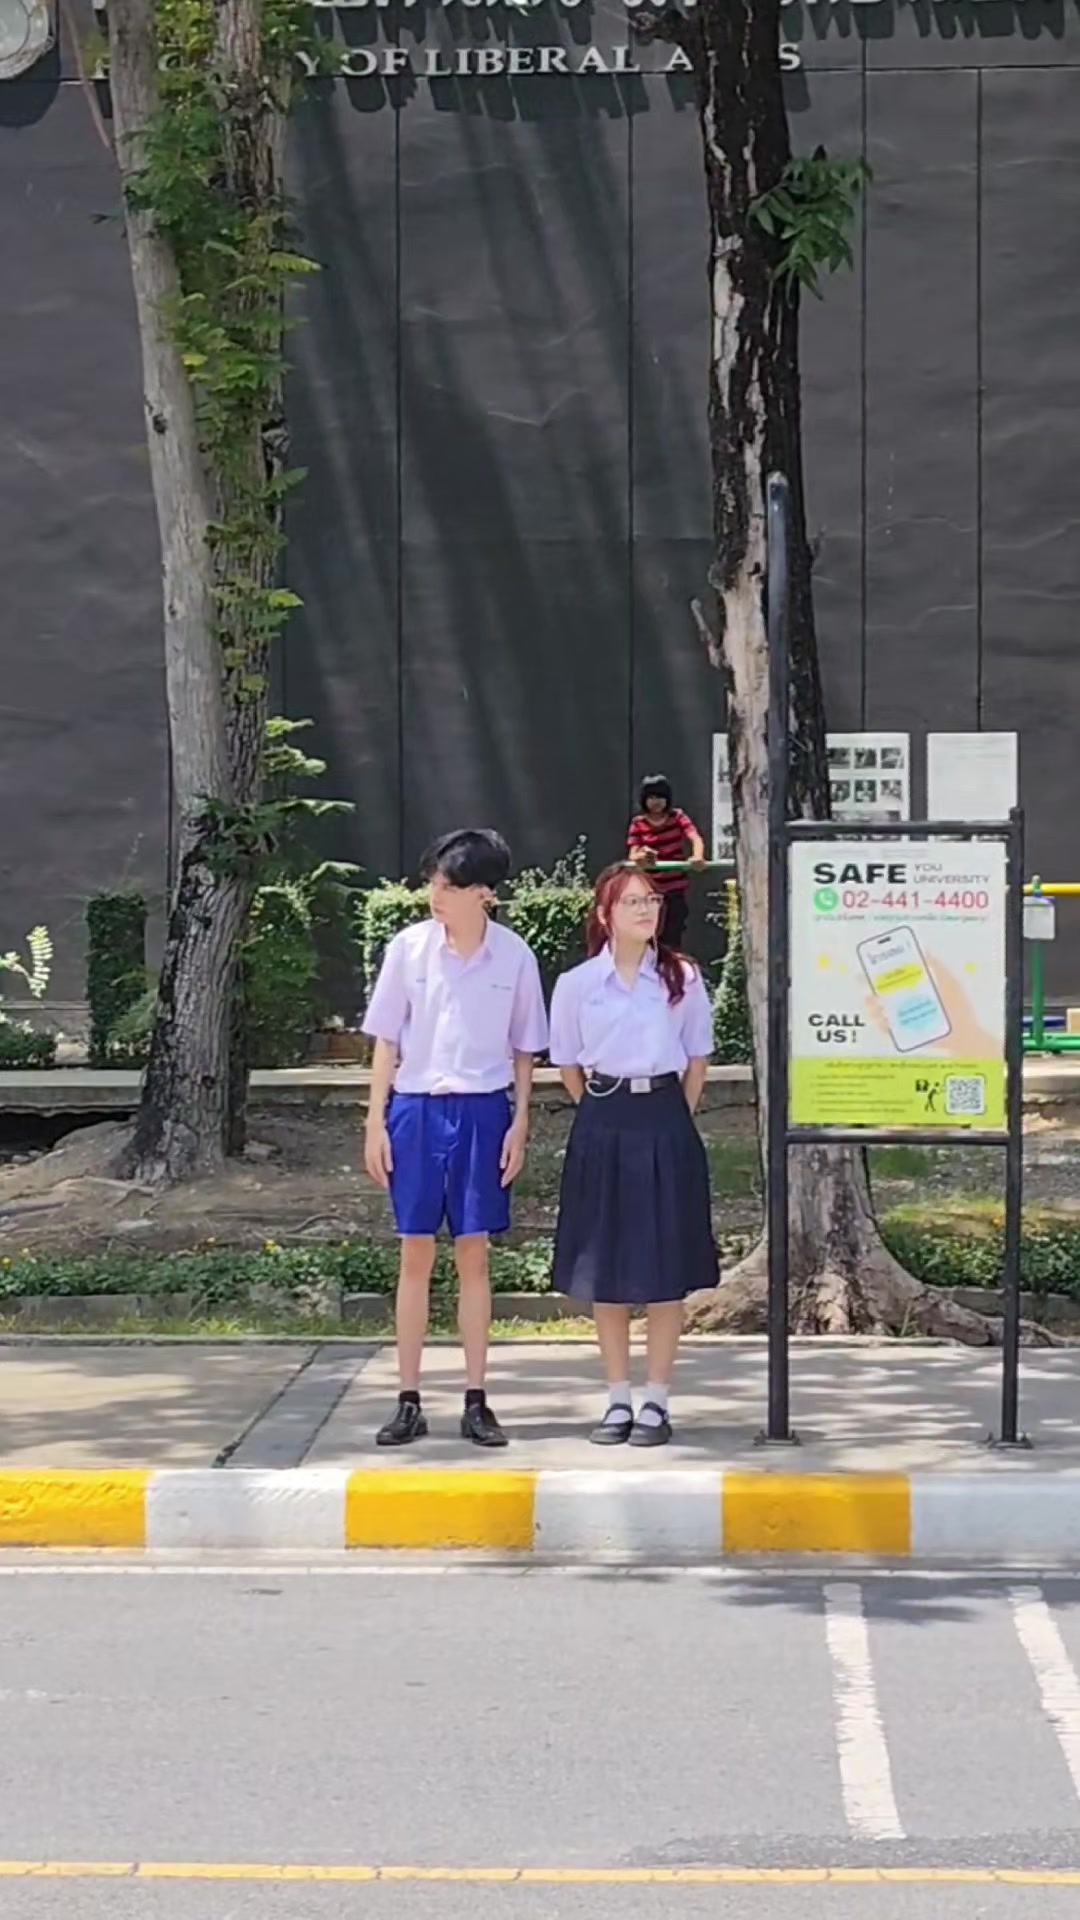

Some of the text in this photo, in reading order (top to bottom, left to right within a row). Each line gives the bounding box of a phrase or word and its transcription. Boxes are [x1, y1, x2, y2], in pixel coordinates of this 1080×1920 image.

[339, 48, 408, 76] OF
[424, 46, 640, 75] LIBERAL
[665, 43, 800, 71] AS
[813, 862, 906, 884] SAFE
[914, 863, 942, 872] YOU
[913, 874, 989, 884] UNIVERSITY
[842, 890, 989, 909] 02-441-4400
[808, 1014, 865, 1027] CALL
